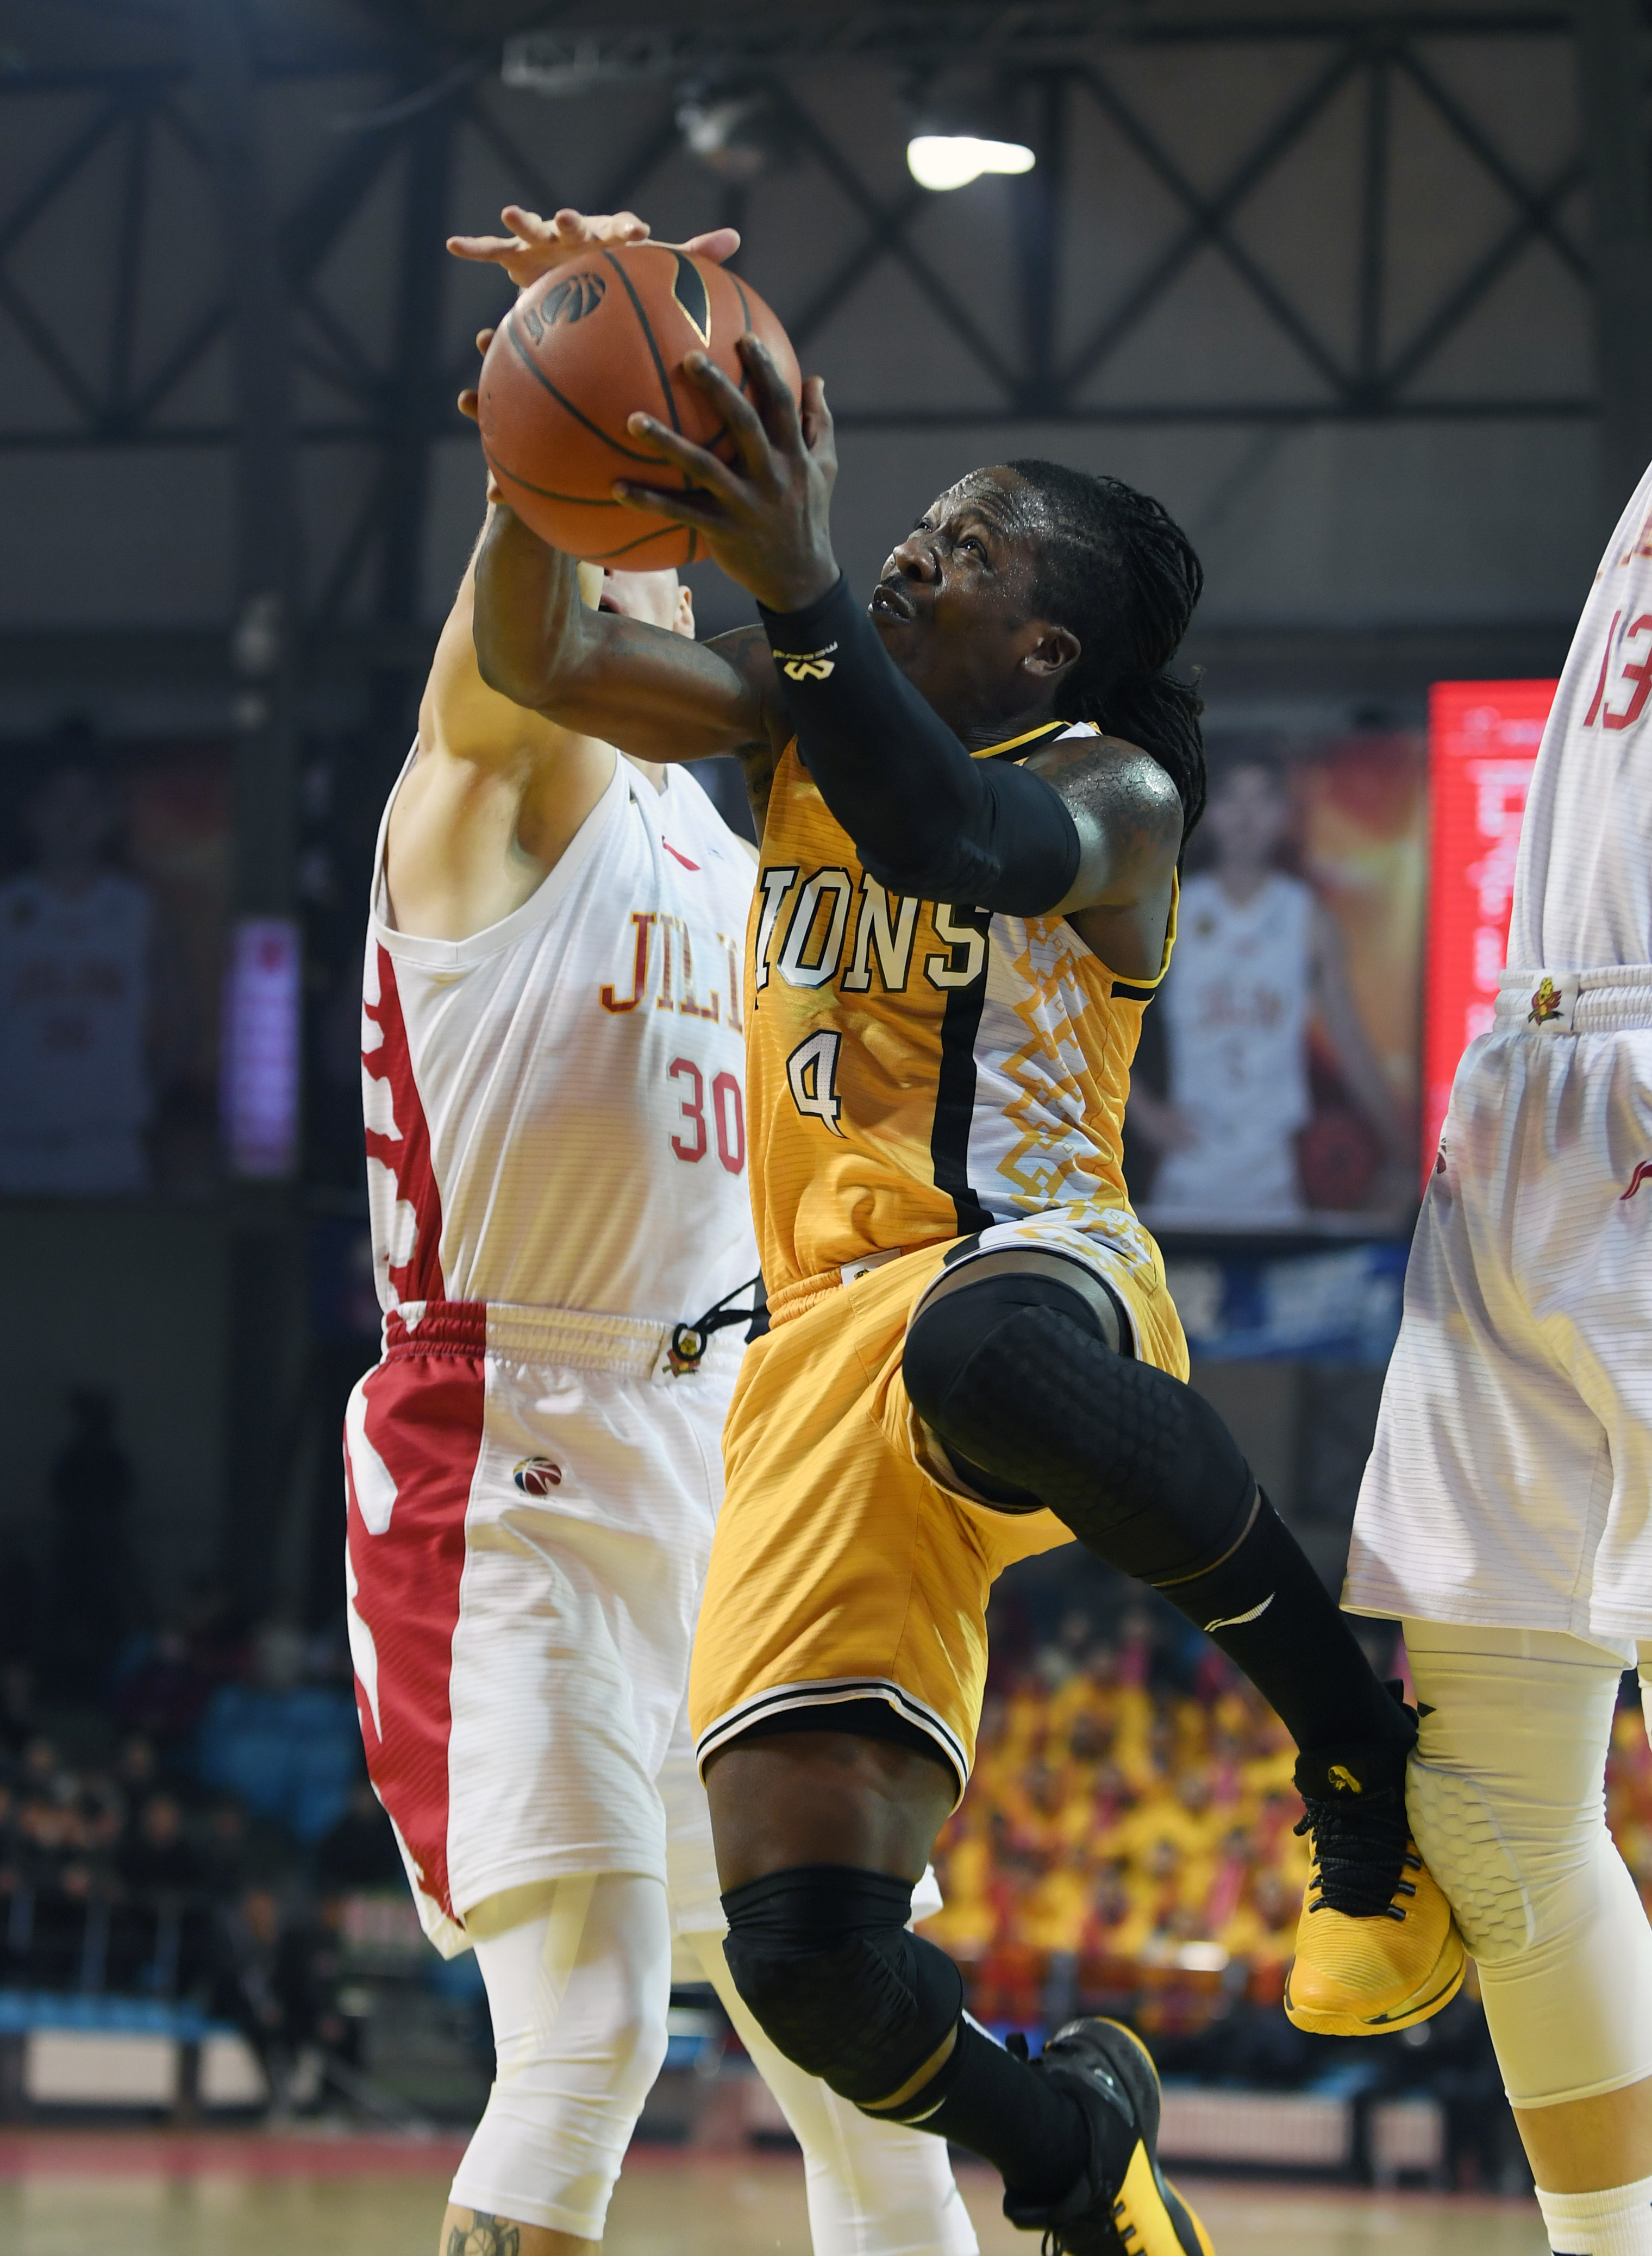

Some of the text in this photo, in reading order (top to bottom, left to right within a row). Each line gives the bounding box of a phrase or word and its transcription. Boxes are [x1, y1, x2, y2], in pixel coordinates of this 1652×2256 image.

[1580, 609, 1652, 733] 13
[599, 911, 745, 1033] JILI
[754, 866, 989, 1010] IONS
[666, 1057, 746, 1176] 30
[786, 1029, 846, 1139] 4
